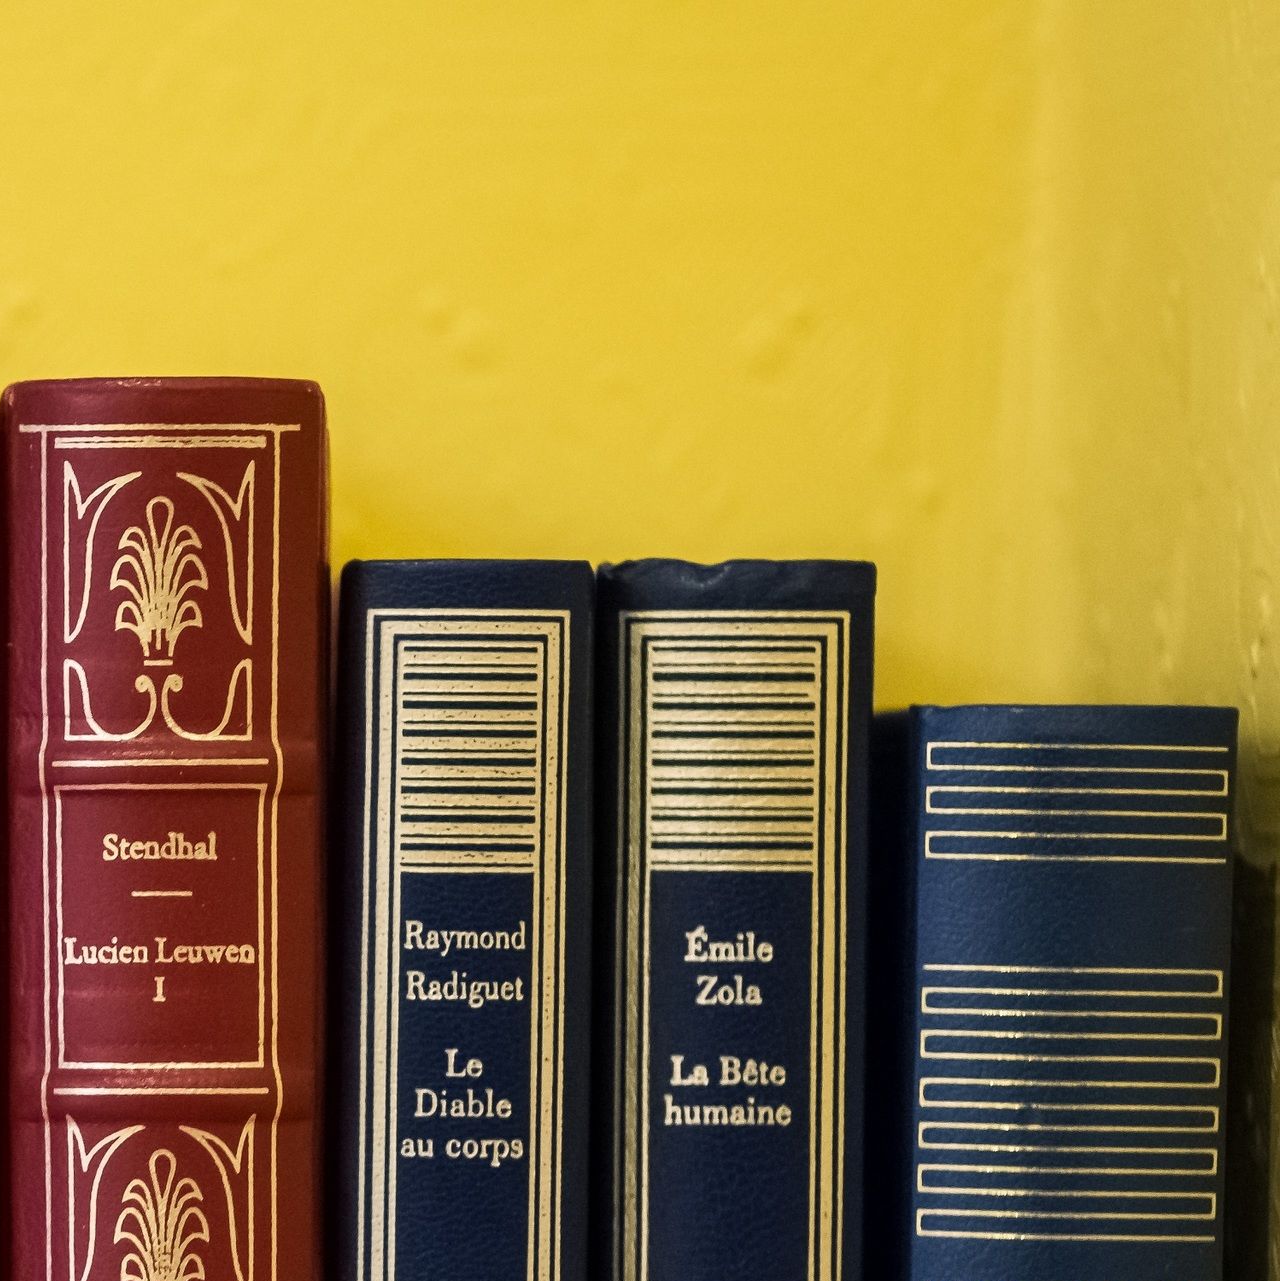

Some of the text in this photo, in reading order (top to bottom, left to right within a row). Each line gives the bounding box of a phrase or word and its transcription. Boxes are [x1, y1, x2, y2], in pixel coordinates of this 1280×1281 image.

[103, 832, 217, 860] Stendhal
[62, 937, 255, 964] Lucien Leuwen
[404, 921, 525, 956] Raymond
[685, 926, 772, 962] Émile
[153, 977, 165, 1002] I
[407, 971, 523, 1008] Radiguet
[697, 976, 762, 1005] Zola
[445, 1049, 482, 1077] Le
[670, 1056, 785, 1085] La Bête
[415, 1089, 511, 1117] Diable
[665, 1095, 791, 1125] humaine
[400, 1138, 525, 1168] au corps
